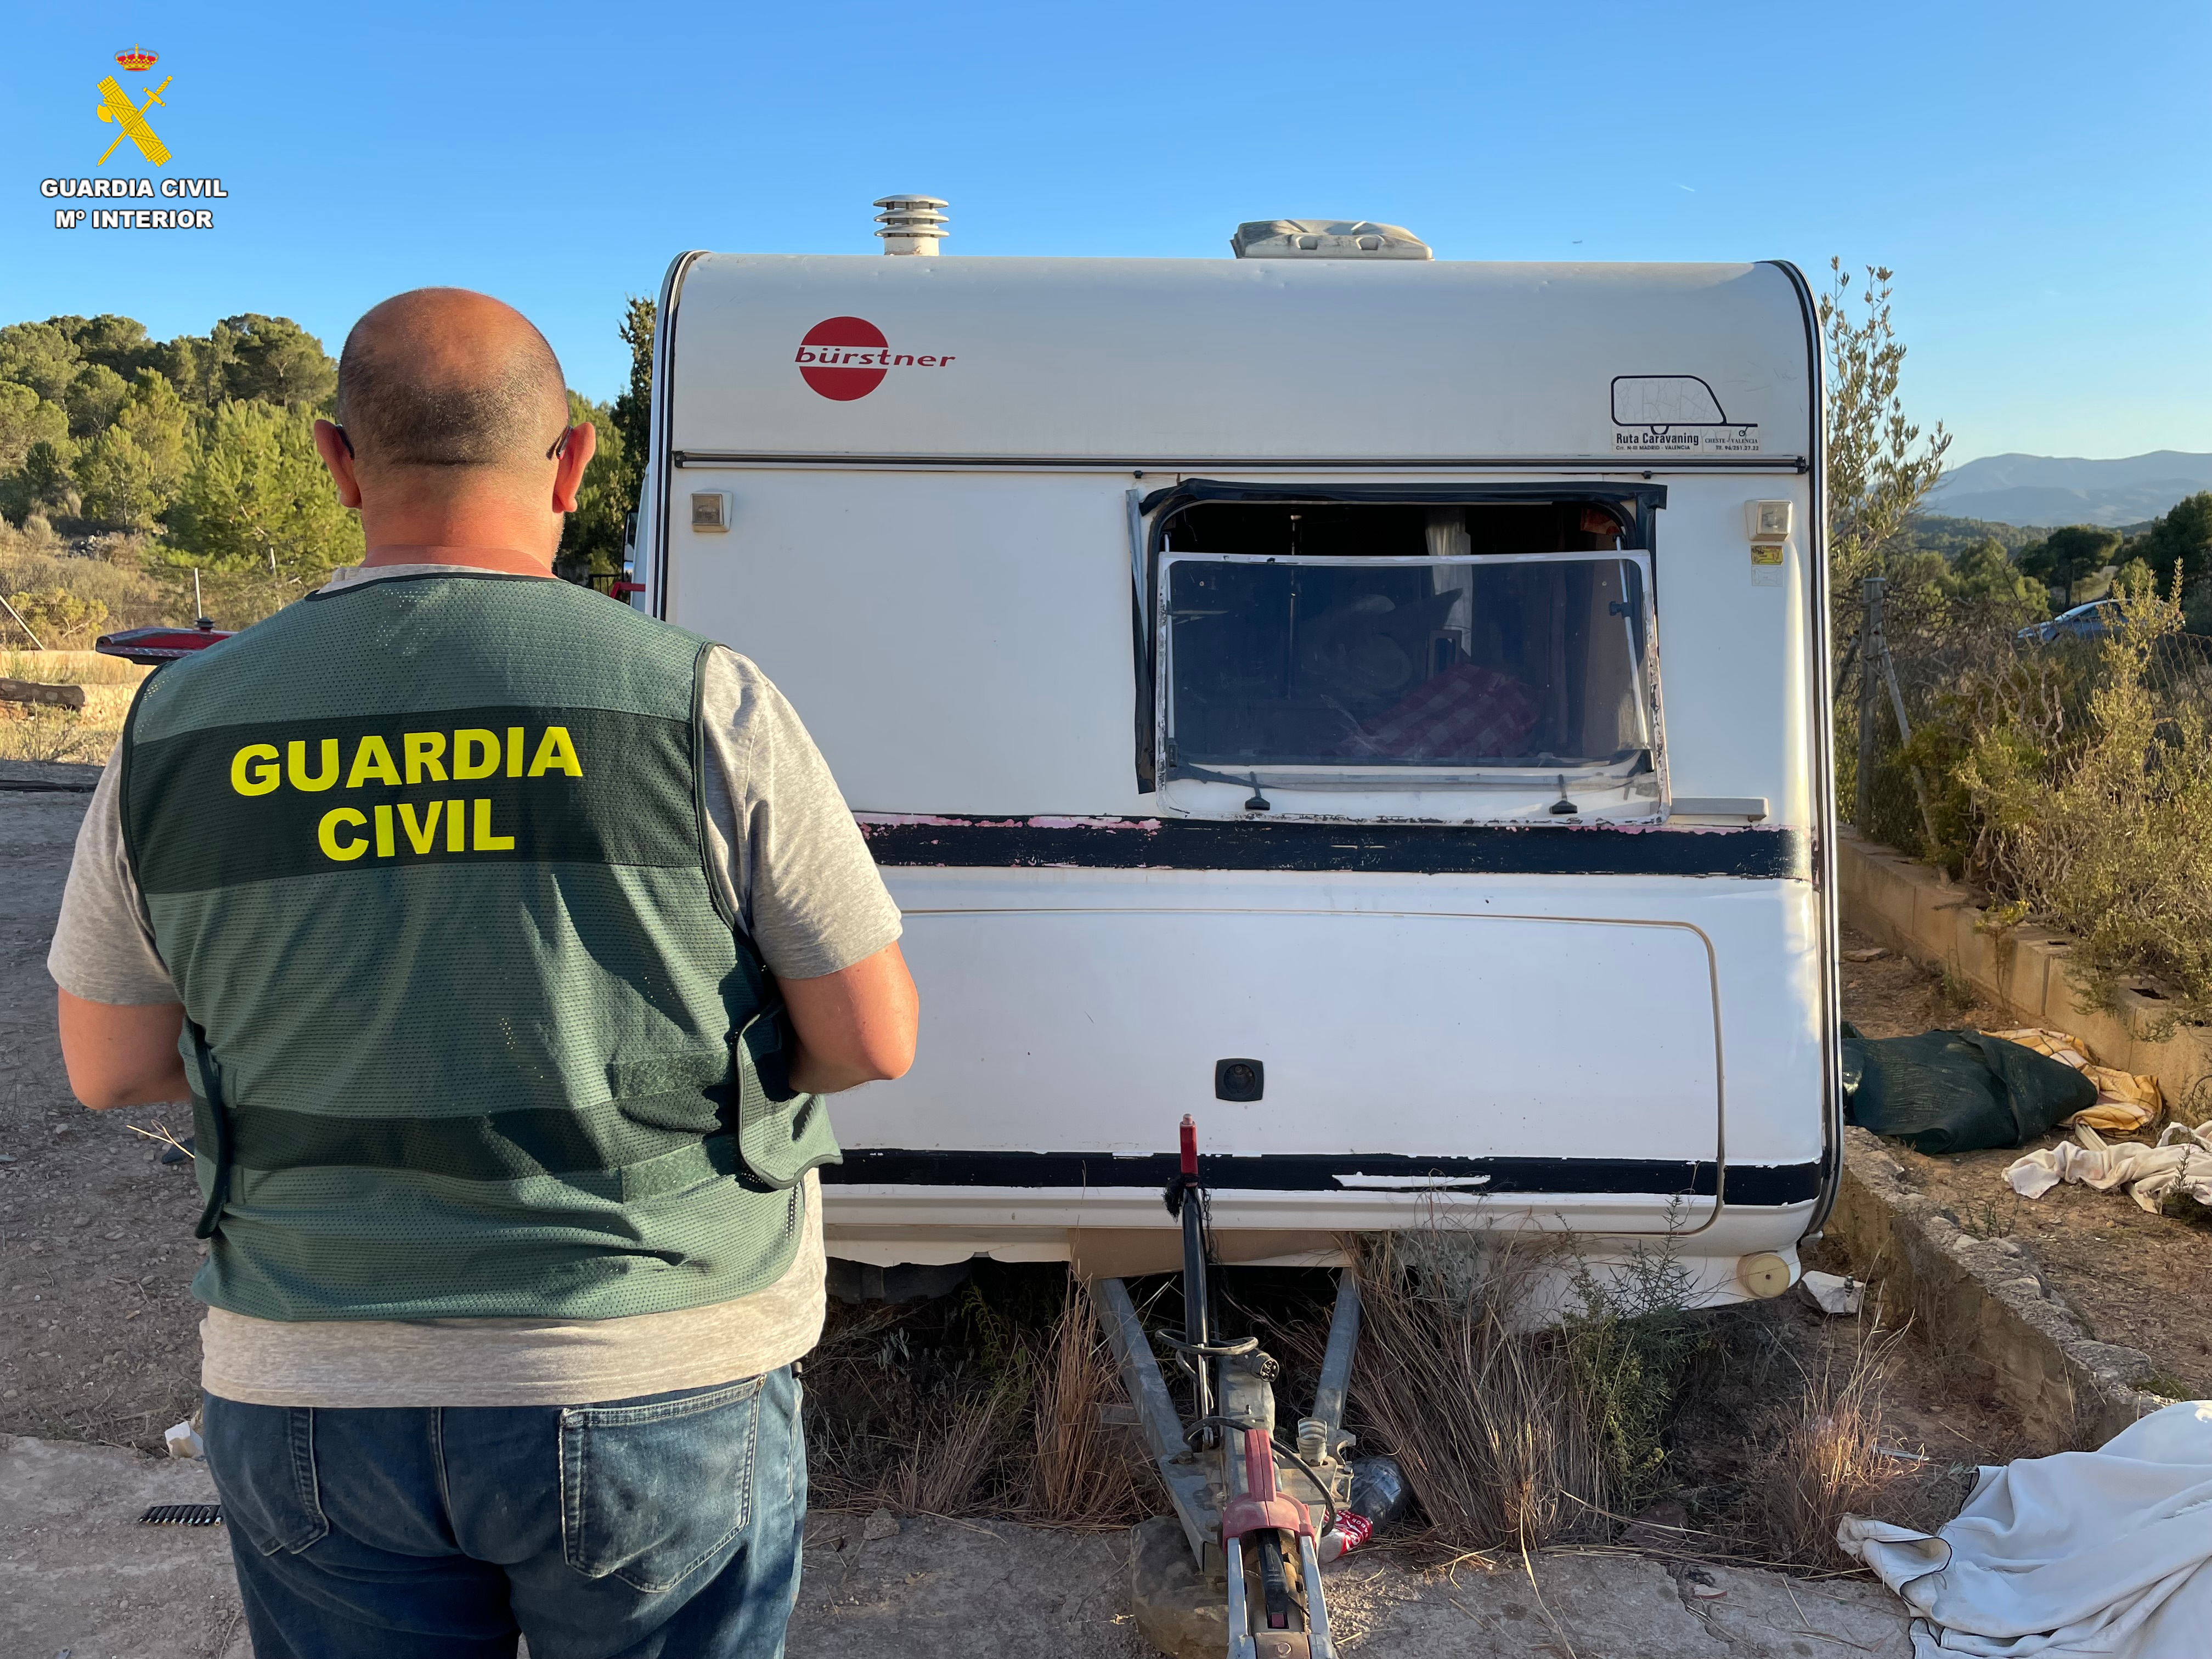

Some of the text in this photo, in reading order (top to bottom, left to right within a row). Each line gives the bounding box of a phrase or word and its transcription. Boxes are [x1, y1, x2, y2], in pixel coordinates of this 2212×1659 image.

[794, 347, 956, 367] bürstner
[1616, 432, 1699, 445] Ruta Caravaning
[230, 726, 583, 796] GUARDIA
[318, 798, 515, 861] CIVIL
